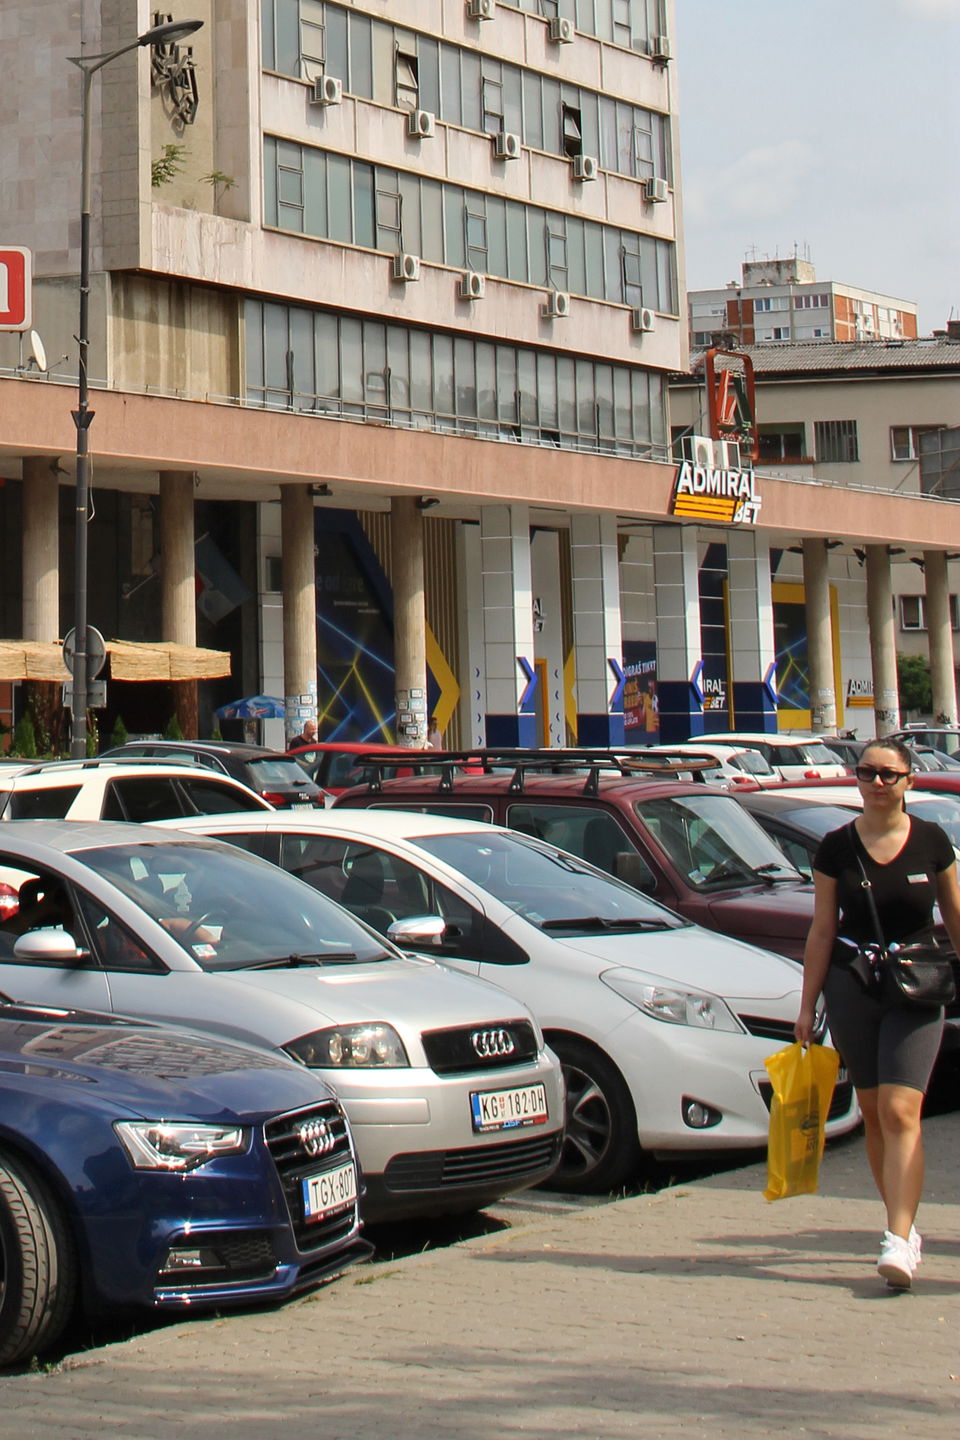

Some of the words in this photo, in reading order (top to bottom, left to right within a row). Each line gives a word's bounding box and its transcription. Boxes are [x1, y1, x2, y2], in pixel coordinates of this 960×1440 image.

[677, 462, 762, 503] ADMIRAL
[733, 502, 762, 524] BET
[703, 679, 726, 695] IRAL
[481, 1096, 499, 1120] KG
[508, 1088, 545, 1116] 182-DH
[312, 1168, 353, 1209] TGX-807
